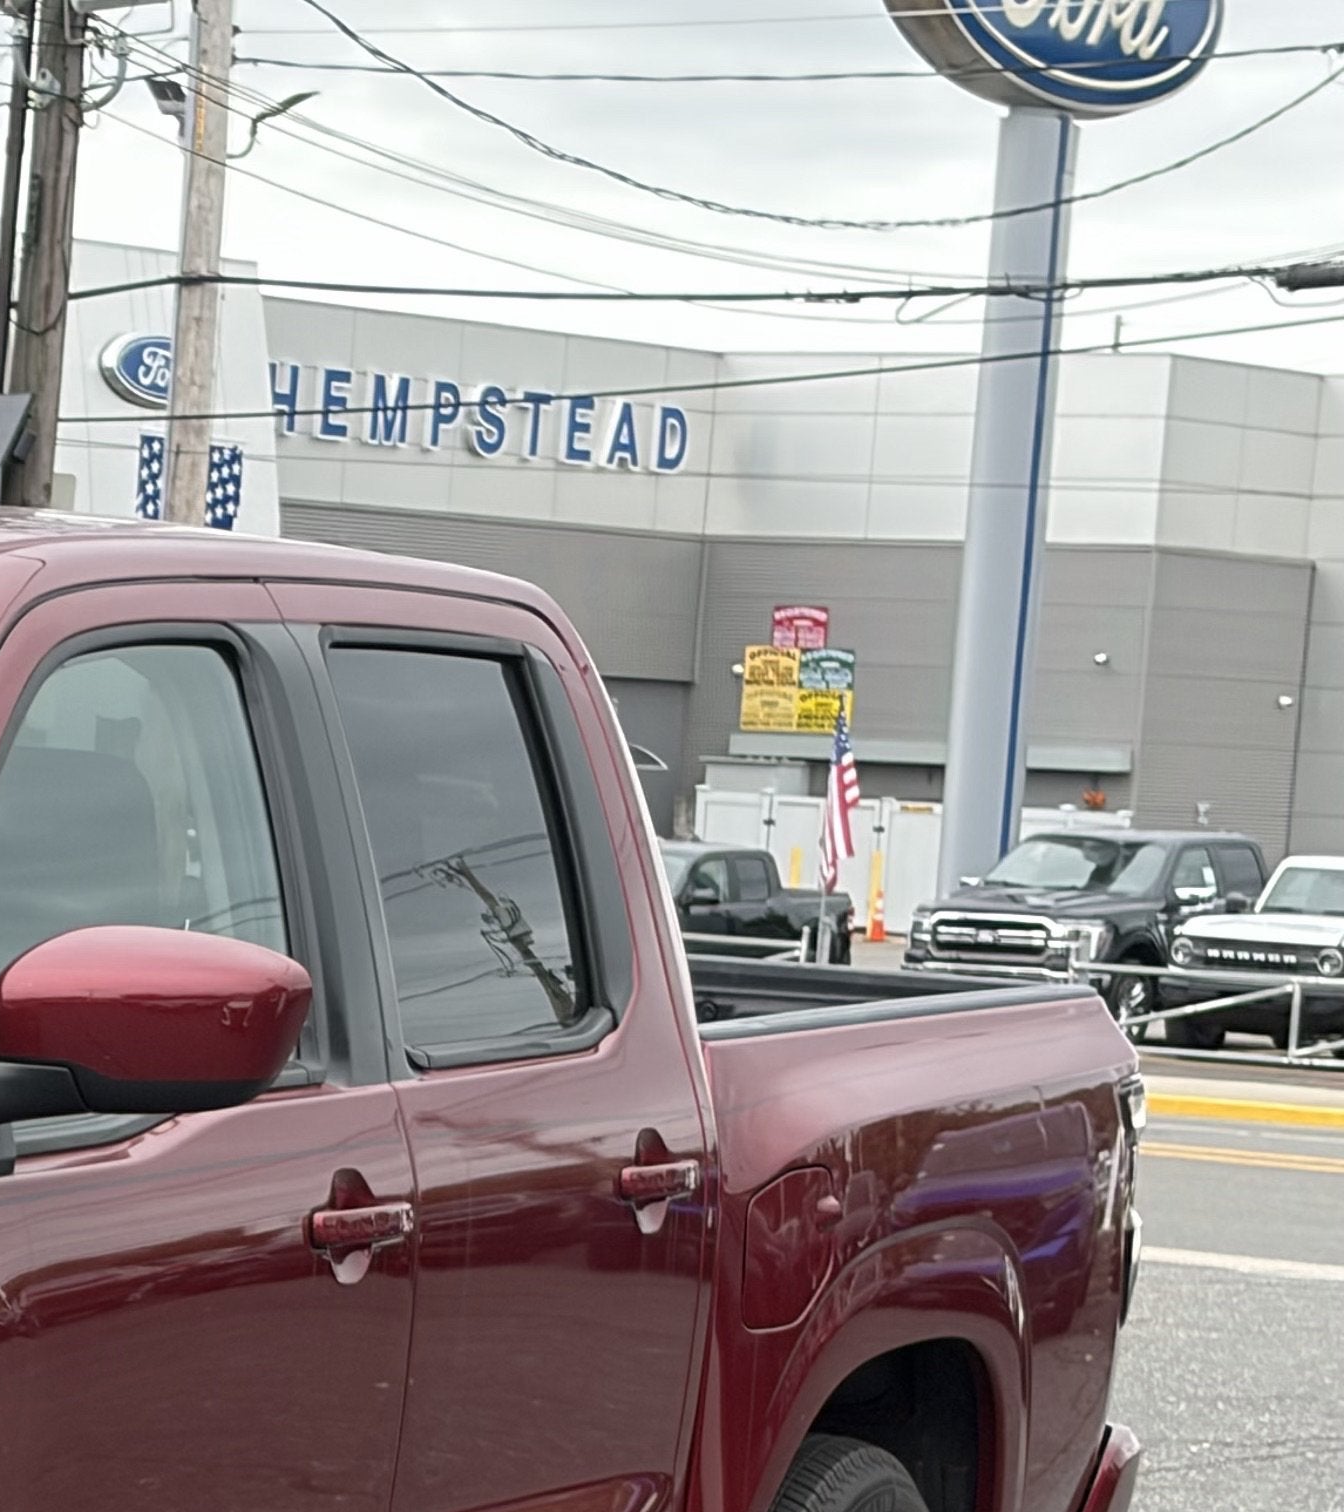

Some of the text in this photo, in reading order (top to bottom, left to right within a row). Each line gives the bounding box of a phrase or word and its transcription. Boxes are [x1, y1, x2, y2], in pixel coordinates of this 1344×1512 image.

[1003, 0, 1169, 60] ord
[138, 346, 172, 388] Fo
[269, 361, 689, 471] HEMPSTEAD
